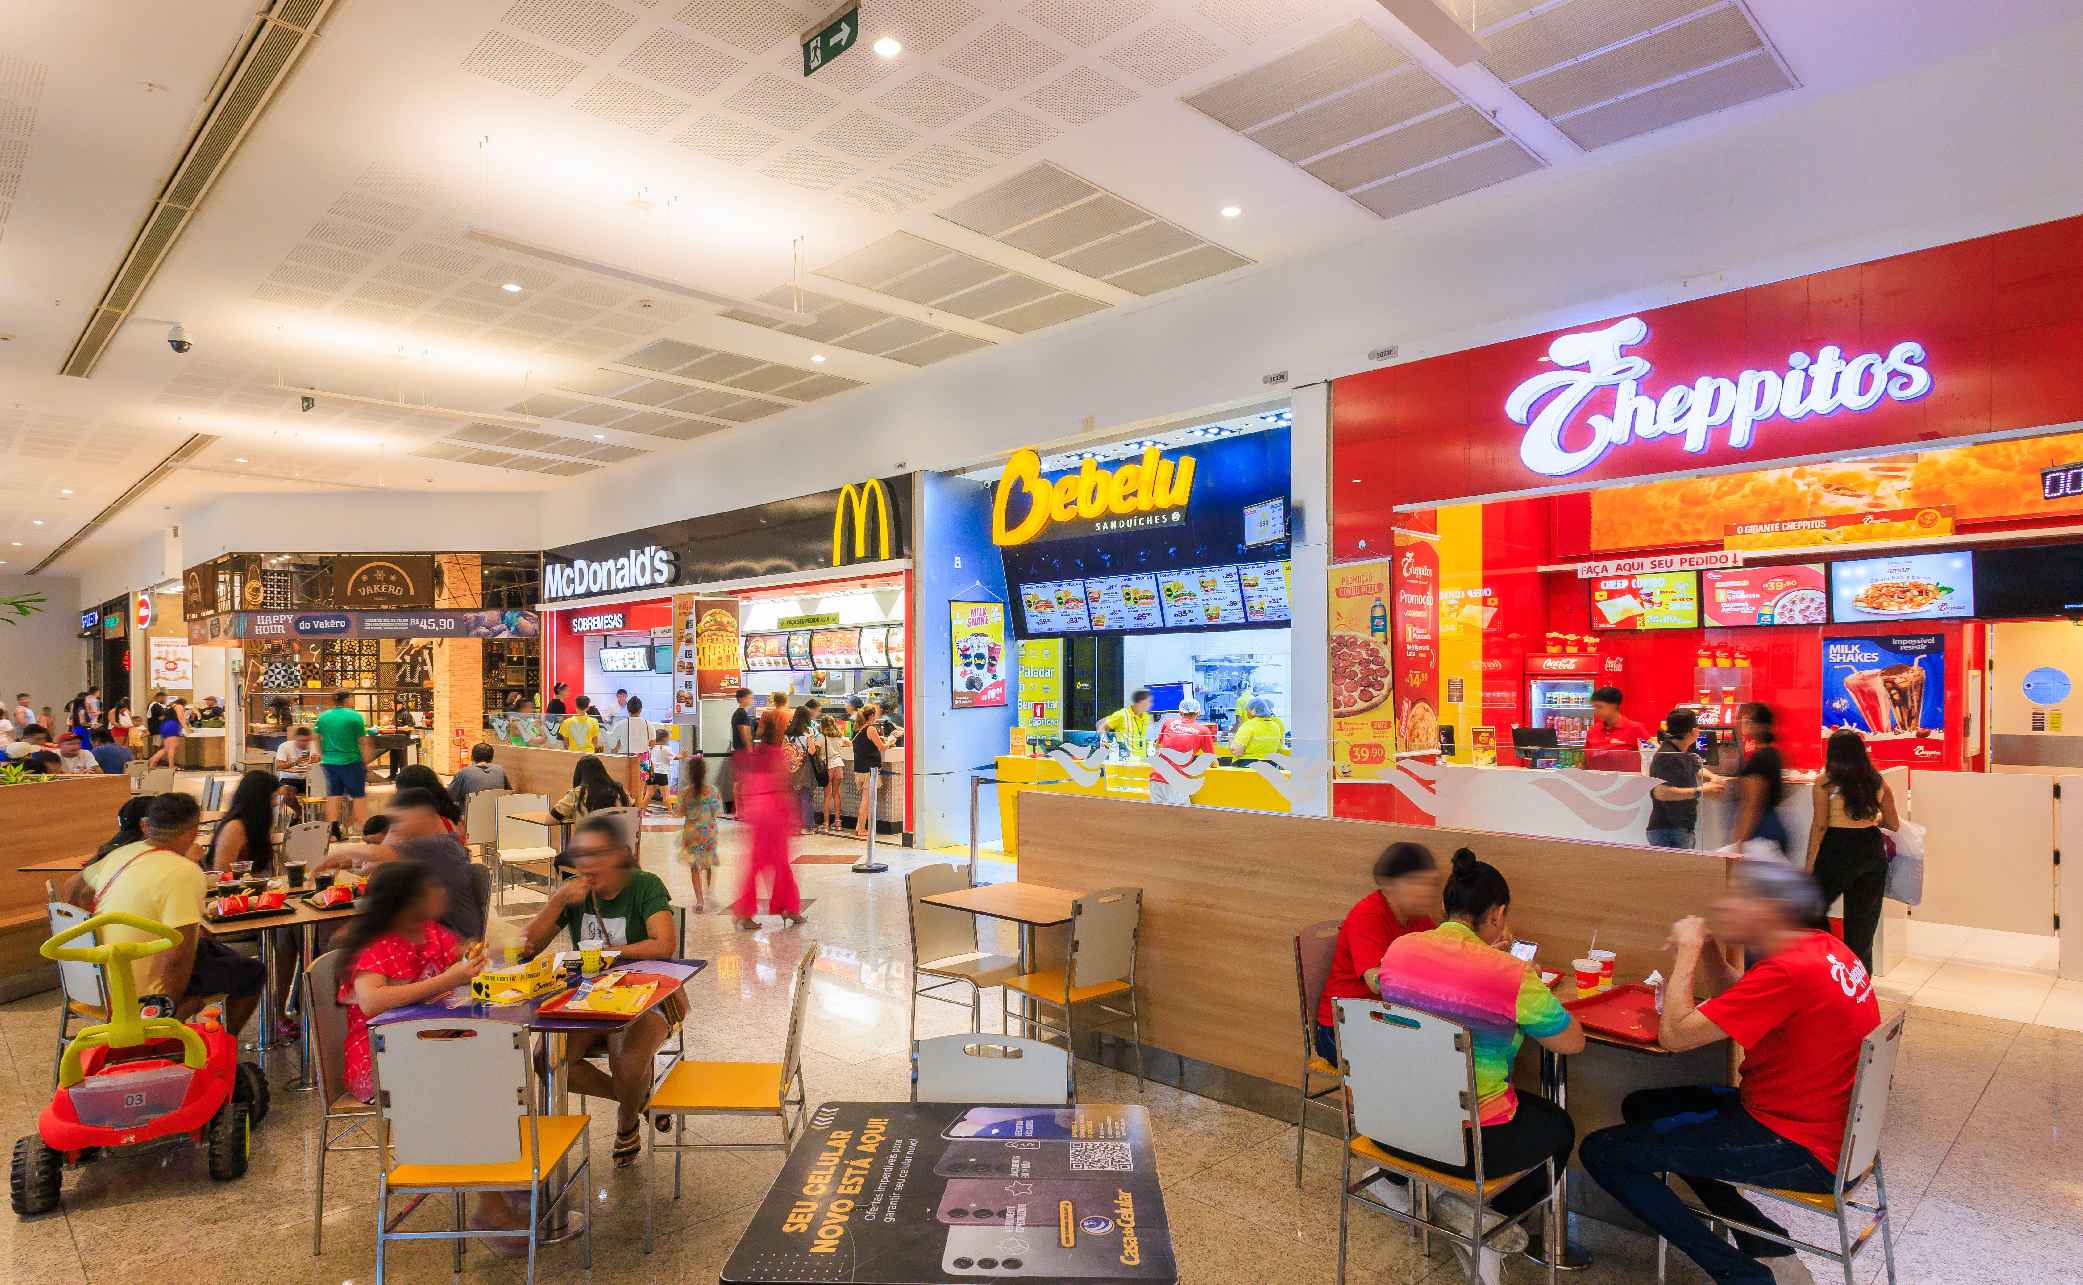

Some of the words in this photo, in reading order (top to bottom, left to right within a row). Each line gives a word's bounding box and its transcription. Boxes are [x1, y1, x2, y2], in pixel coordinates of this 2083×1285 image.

[1505, 316, 1932, 477] Cheppitos
[992, 446, 1197, 546] Bebelu
[544, 545, 669, 599] McDonald's
[1615, 562, 1644, 573] AQUI
[1650, 558, 1673, 569] SEU
[1680, 554, 1729, 567] PEDIDO
[257, 614, 294, 625] HAPPY
[299, 619, 310, 630] do
[420, 618, 455, 631] 45,90
[572, 613, 624, 632] SOBREMESAS
[255, 624, 286, 635] HOUR
[1829, 644, 1861, 653] MILK
[1829, 653, 1879, 663] SHAKES
[1018, 666, 1055, 678] Paladar
[126, 1094, 143, 1106] 03
[782, 1200, 818, 1232] SEU
[802, 1130, 854, 1196] CELULAR
[809, 1199, 855, 1253] NOVO
[836, 1157, 874, 1194] ESTÁ
[856, 1118, 889, 1153] AQUI!
[883, 1193, 901, 1224] garantir
[1113, 1190, 1136, 1228] Celular
[1119, 1236, 1141, 1266] Casa
